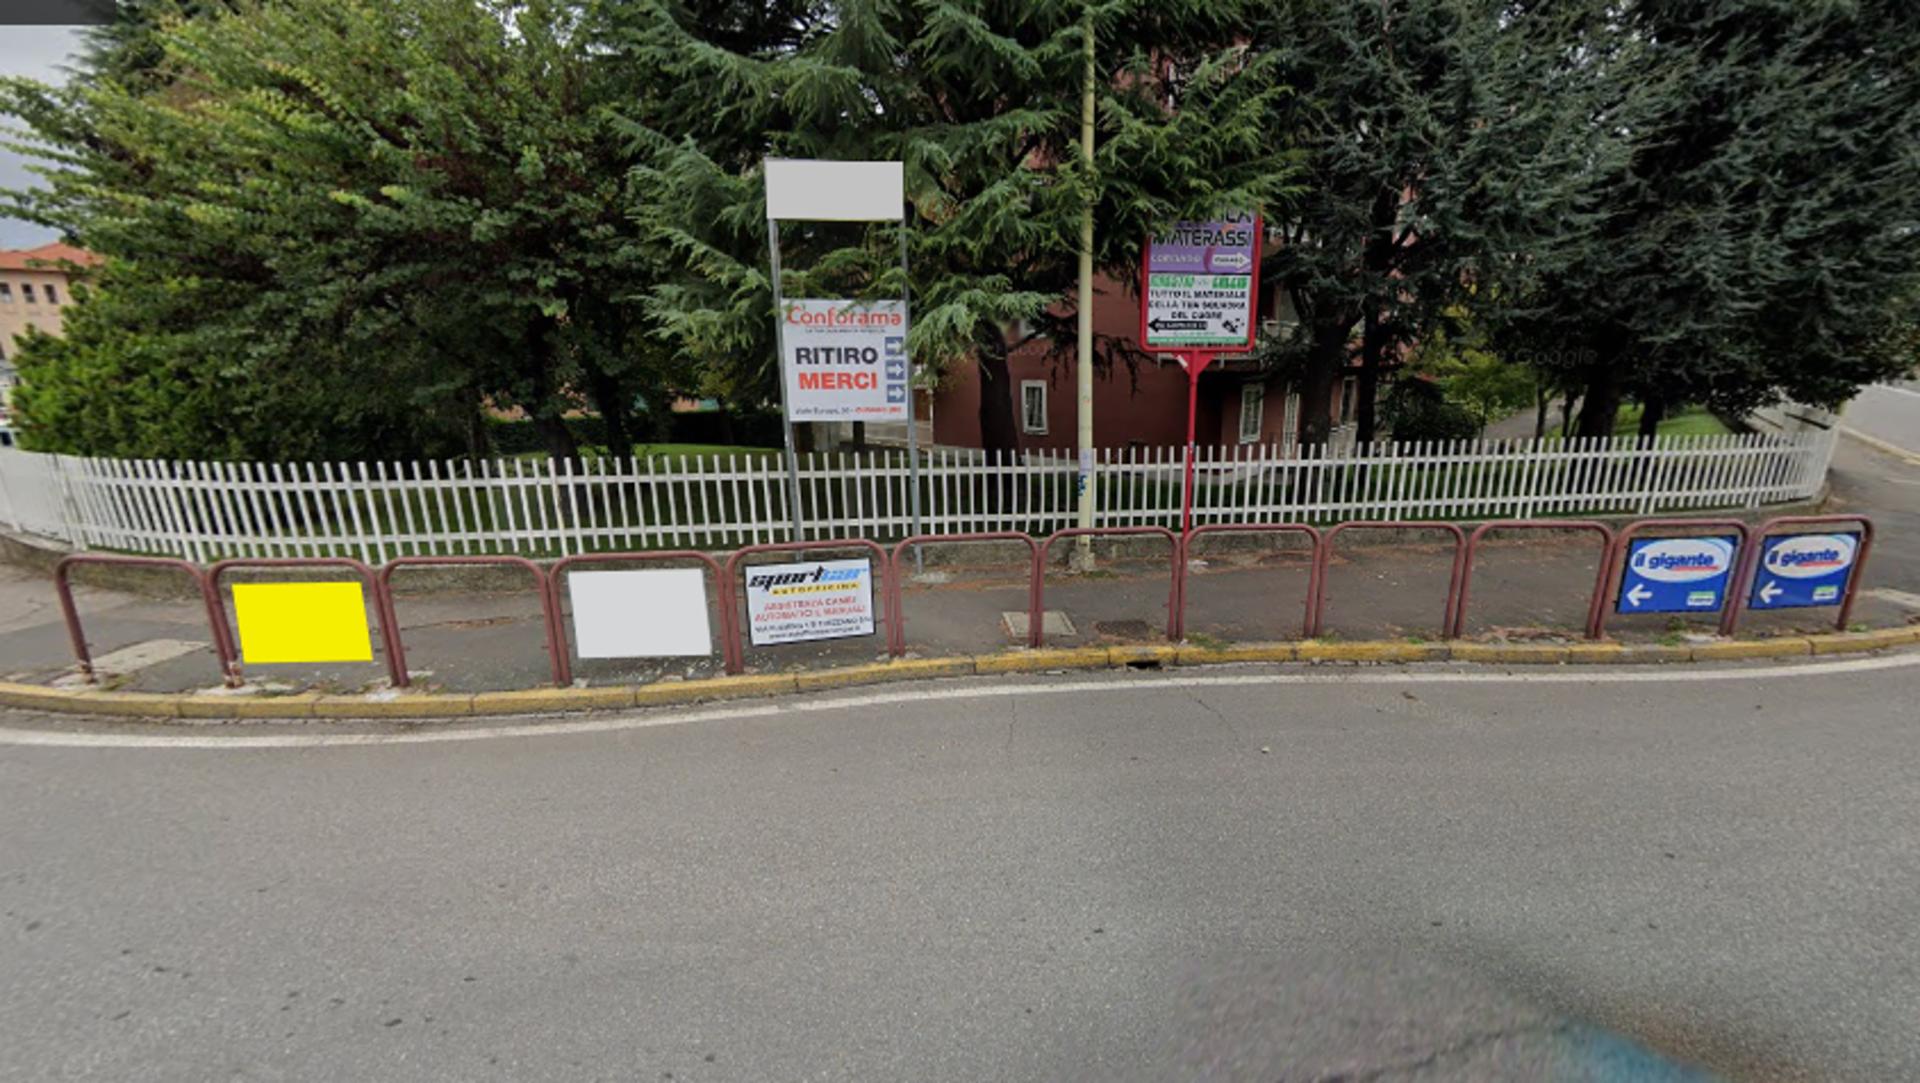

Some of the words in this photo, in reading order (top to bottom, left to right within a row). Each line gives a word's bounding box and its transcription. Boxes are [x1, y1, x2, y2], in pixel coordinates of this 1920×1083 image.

[1152, 229, 1252, 247] MATERASSI
[1149, 290, 1181, 299] TUTTO
[1194, 290, 1247, 300] MATERIALE
[1148, 300, 1179, 309] DELLA
[1202, 301, 1246, 310] SQUADRA
[787, 306, 902, 327] Conforama
[1171, 311, 1188, 319] DEL
[1191, 311, 1223, 320] CUORE
[795, 347, 879, 365] RITIRO
[798, 372, 878, 390] MERCI
[1634, 552, 1645, 568] il
[1648, 552, 1715, 570] gigante
[1768, 550, 1780, 565] il
[1780, 548, 1840, 566] gigante
[764, 598, 824, 611] ASSISTENZA
